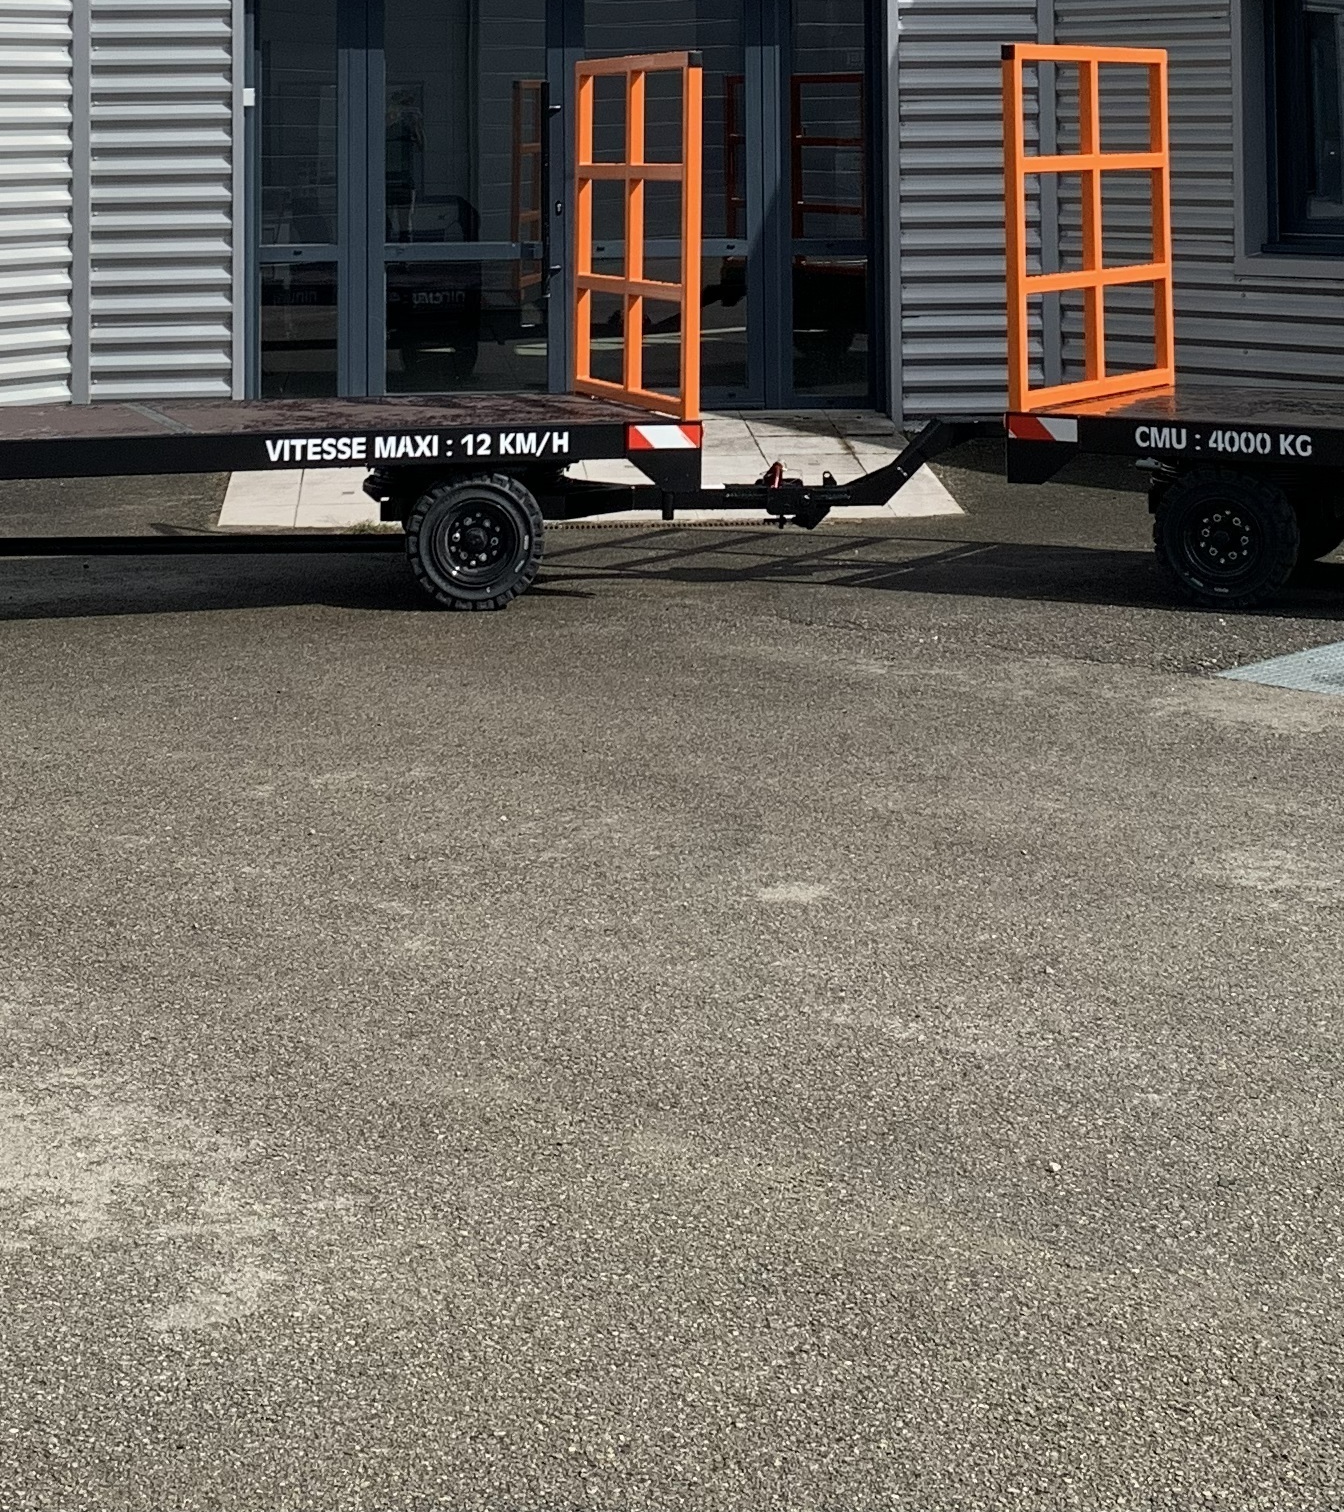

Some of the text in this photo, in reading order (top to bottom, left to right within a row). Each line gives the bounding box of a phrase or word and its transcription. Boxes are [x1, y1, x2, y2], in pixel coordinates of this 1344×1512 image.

[265, 436, 367, 462] VITESSE
[374, 434, 439, 459] MAXI
[460, 432, 492, 456] 12
[499, 431, 569, 458] KM/H
[1135, 426, 1187, 450] CMU
[1208, 430, 1272, 454] 4000
[1279, 433, 1313, 457] KG
